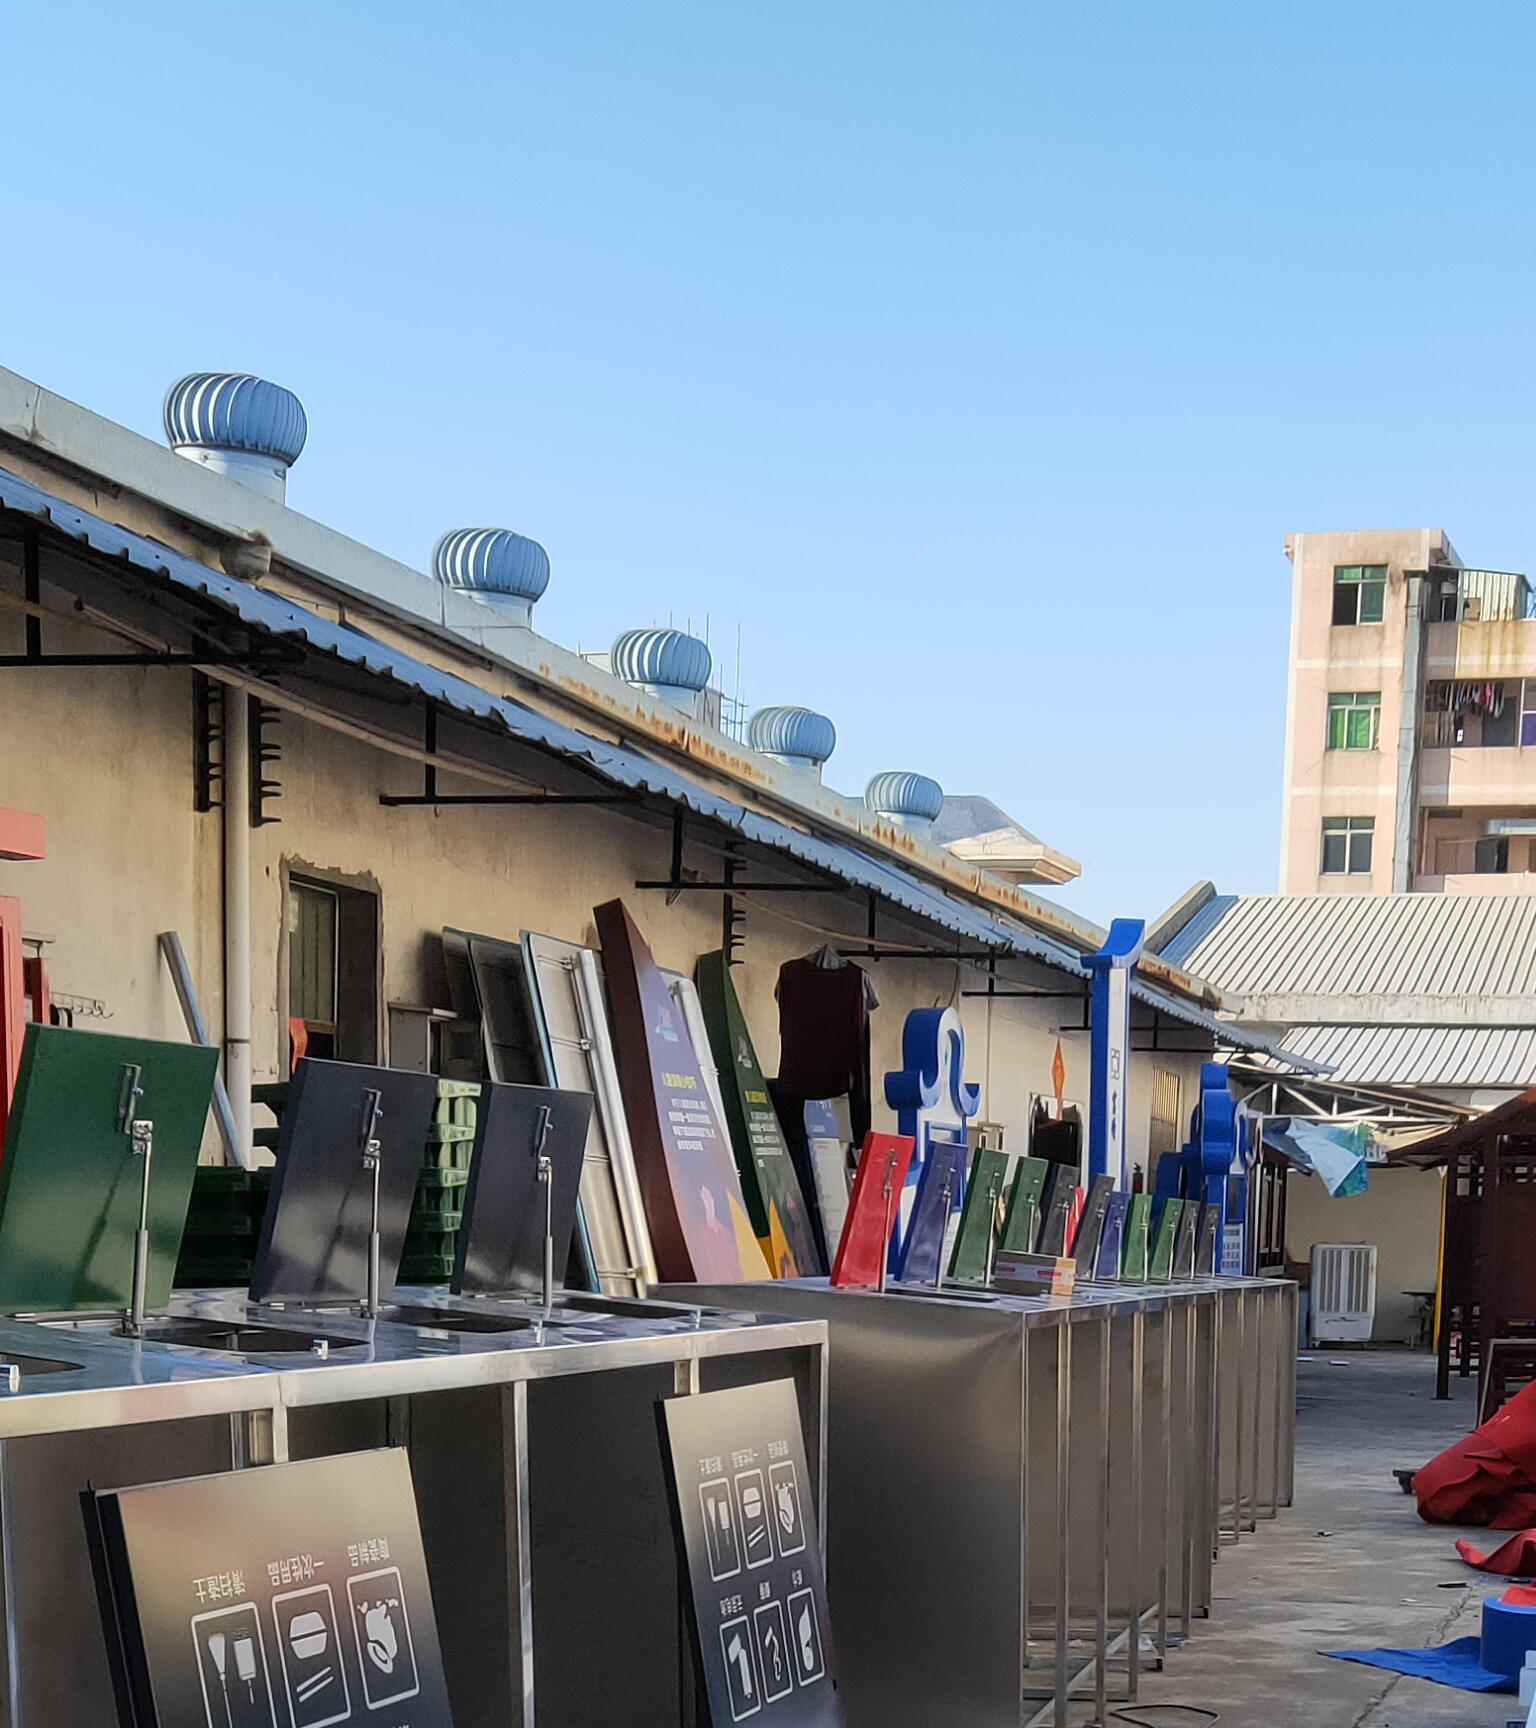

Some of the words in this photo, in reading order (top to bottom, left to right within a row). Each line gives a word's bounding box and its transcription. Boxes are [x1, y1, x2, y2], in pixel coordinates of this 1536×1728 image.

[346, 1536, 390, 1567] 陶瓷制品
[192, 1569, 246, 1603] 清扫渣土
[266, 1553, 325, 1587] 一次性用品
